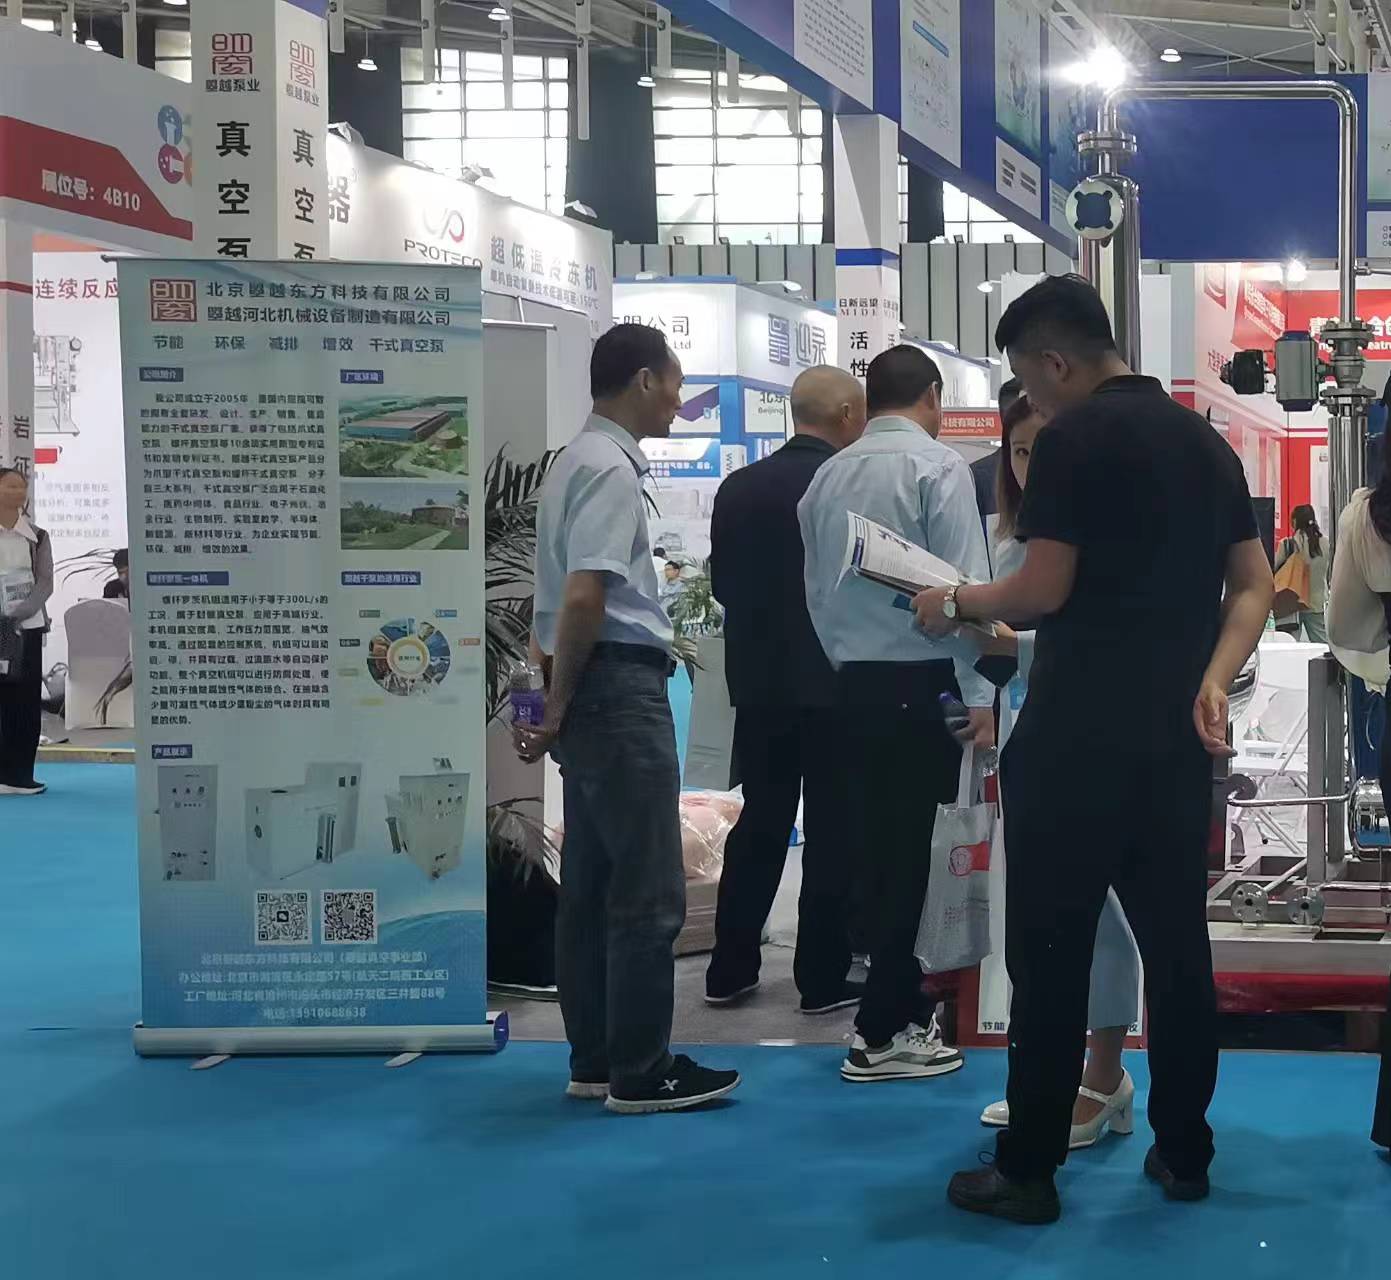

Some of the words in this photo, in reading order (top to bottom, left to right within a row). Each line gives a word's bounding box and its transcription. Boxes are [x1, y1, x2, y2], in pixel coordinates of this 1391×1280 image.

[839, 298, 878, 308] 日新远望
[152, 335, 184, 350] 节能
[215, 335, 246, 350] 环保
[268, 336, 298, 351] 减排
[322, 336, 353, 352] 增效
[369, 337, 445, 353] 干式真空泵
